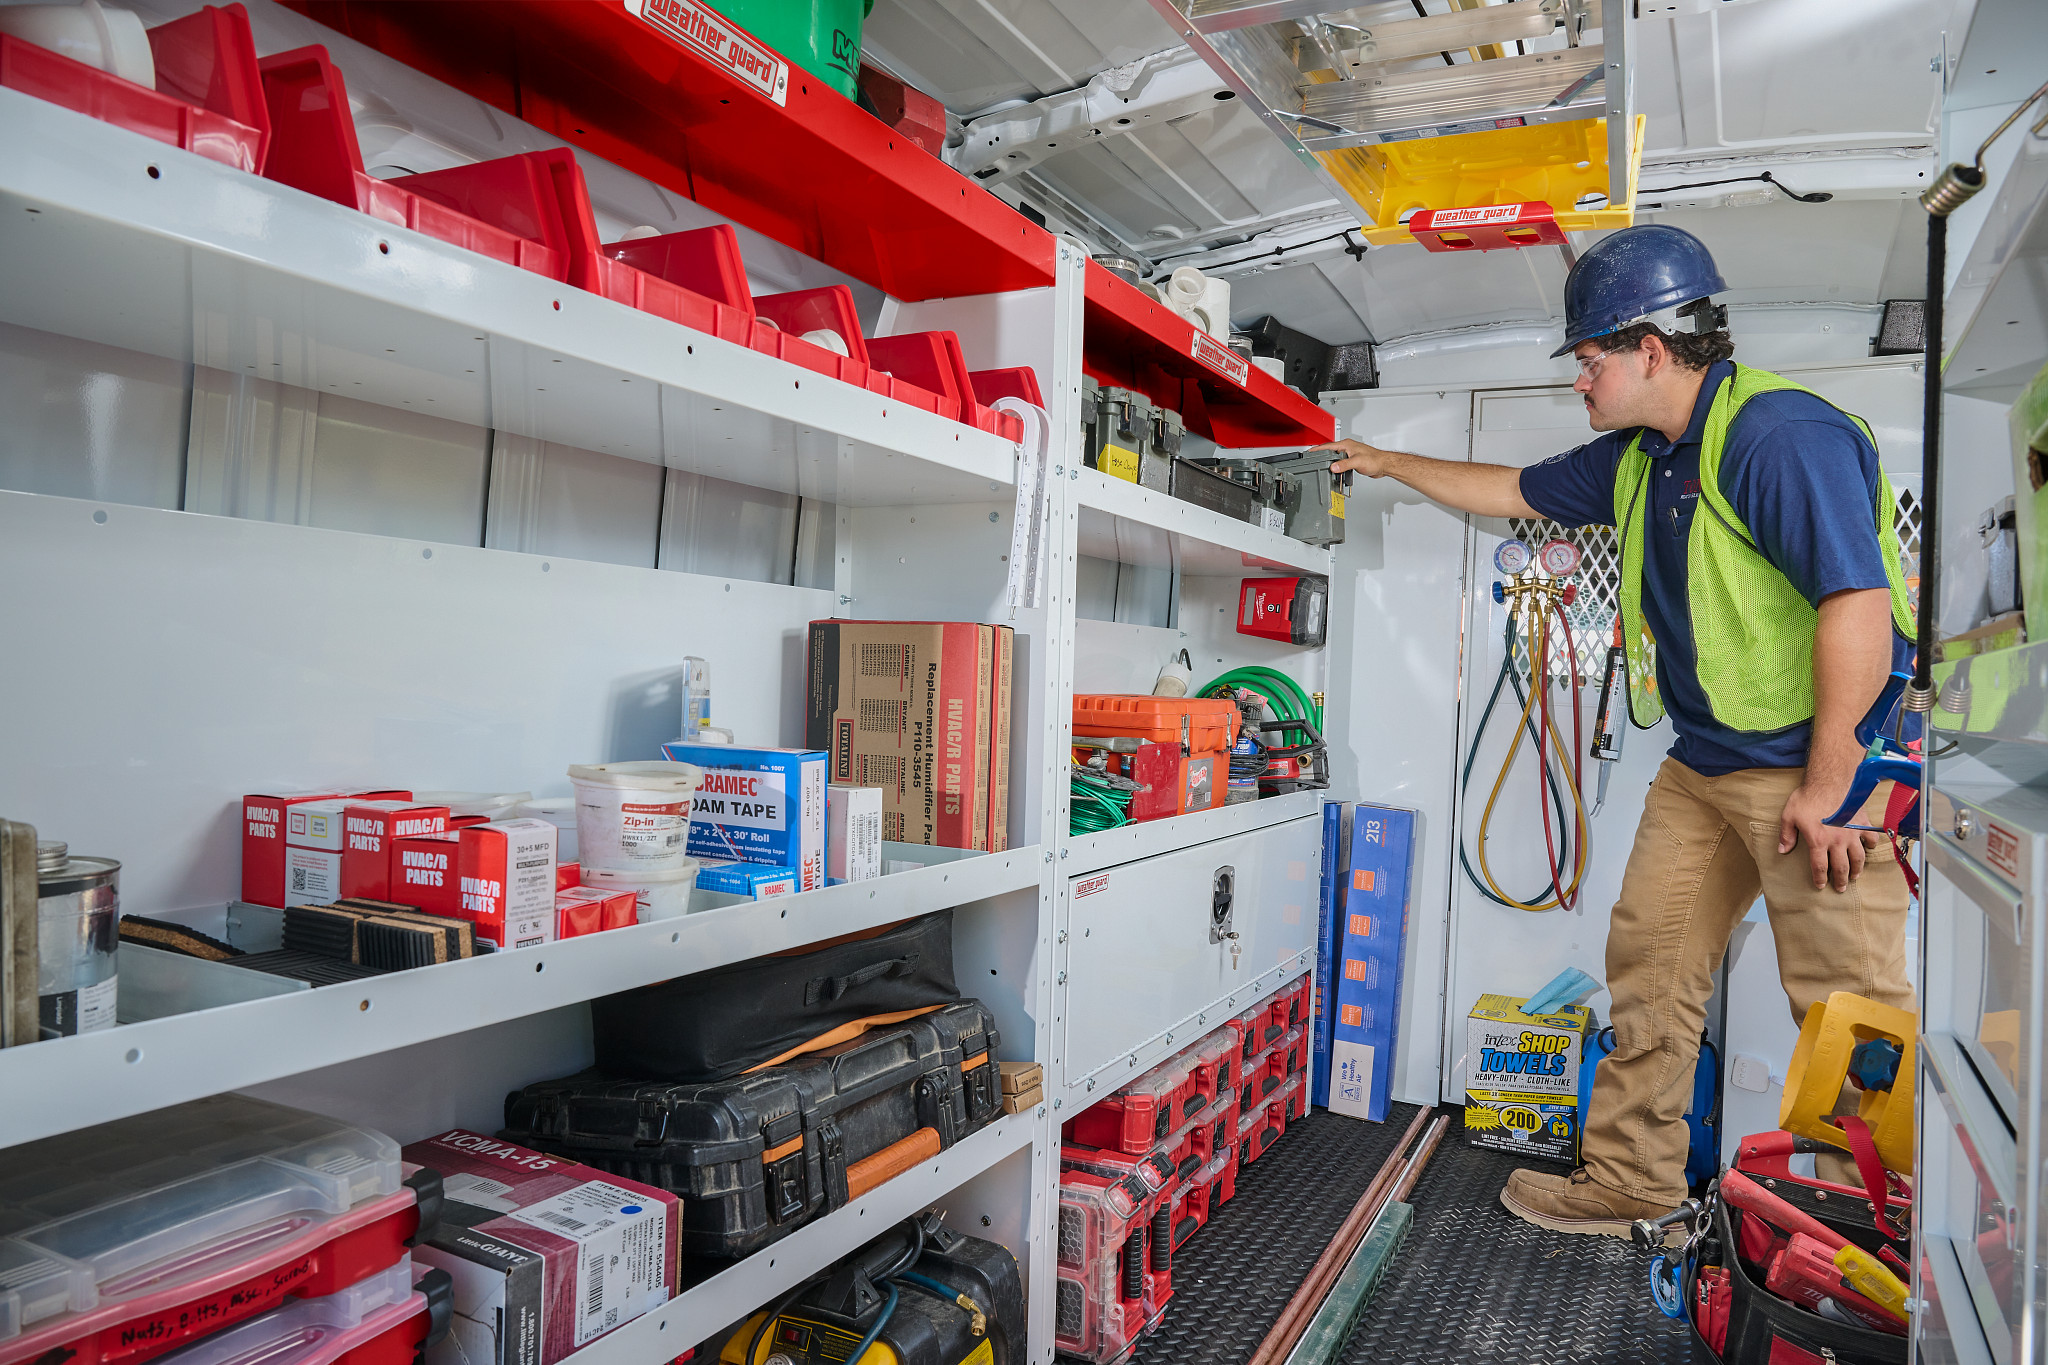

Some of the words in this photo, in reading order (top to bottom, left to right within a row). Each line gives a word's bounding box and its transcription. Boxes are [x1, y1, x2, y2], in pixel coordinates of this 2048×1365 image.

[649, 0, 728, 52] weather
[729, 41, 774, 84] guard
[1435, 210, 1482, 222] weather
[1483, 205, 1518, 220] guard
[1200, 342, 1226, 367] weather
[1225, 358, 1243, 377] guard
[924, 662, 938, 750] Replacement
[946, 698, 964, 759] HVAC/R
[839, 722, 850, 778] TOTALINE
[913, 721, 924, 789] P110-3545
[924, 752, 934, 821] Humidifier
[945, 760, 962, 816] PARTS
[246, 805, 280, 823] HVAC/R
[730, 801, 777, 820] TAPE
[249, 822, 276, 839] PARTS
[346, 817, 384, 836] HVAC/R
[396, 817, 445, 836] HVAC/R
[623, 816, 654, 828] Zip-in
[1365, 820, 1381, 844] 213
[349, 834, 380, 853] PARTS
[733, 830, 749, 840] 30'
[750, 832, 770, 843] Roll
[516, 844, 534, 854] 30+5
[534, 842, 550, 851] MFD
[695, 839, 729, 850] self-adhesive
[729, 843, 744, 851] foam
[744, 845, 772, 855] insulating
[772, 847, 786, 856] tape
[402, 850, 448, 870] HVAC/R
[691, 850, 711, 858] prevent
[712, 851, 748, 862] condensation
[753, 856, 777, 866] dripping
[814, 848, 822, 878] TAPE
[406, 868, 443, 887] PARTS
[460, 876, 500, 898] HVAC/R
[1077, 881, 1096, 893] weather
[1095, 876, 1107, 889] guard
[764, 883, 785, 896] BRAMEC
[462, 893, 495, 914] PARTS
[1484, 1033, 1519, 1047] intex
[1517, 1030, 1571, 1054] SHOP
[1348, 1058, 1358, 1082] Healthy
[1480, 1047, 1567, 1076] TOWELS
[1341, 1069, 1348, 1080] We
[1474, 1073, 1518, 1083] HEAVY-DUTY
[1527, 1076, 1571, 1087] CLOTH-LIKE
[1506, 1110, 1536, 1130] 200
[441, 1131, 558, 1170] VCMA-15
[456, 1236, 481, 1248] Little
[480, 1243, 529, 1264] GIANT
[655, 1253, 663, 1289] 554405
